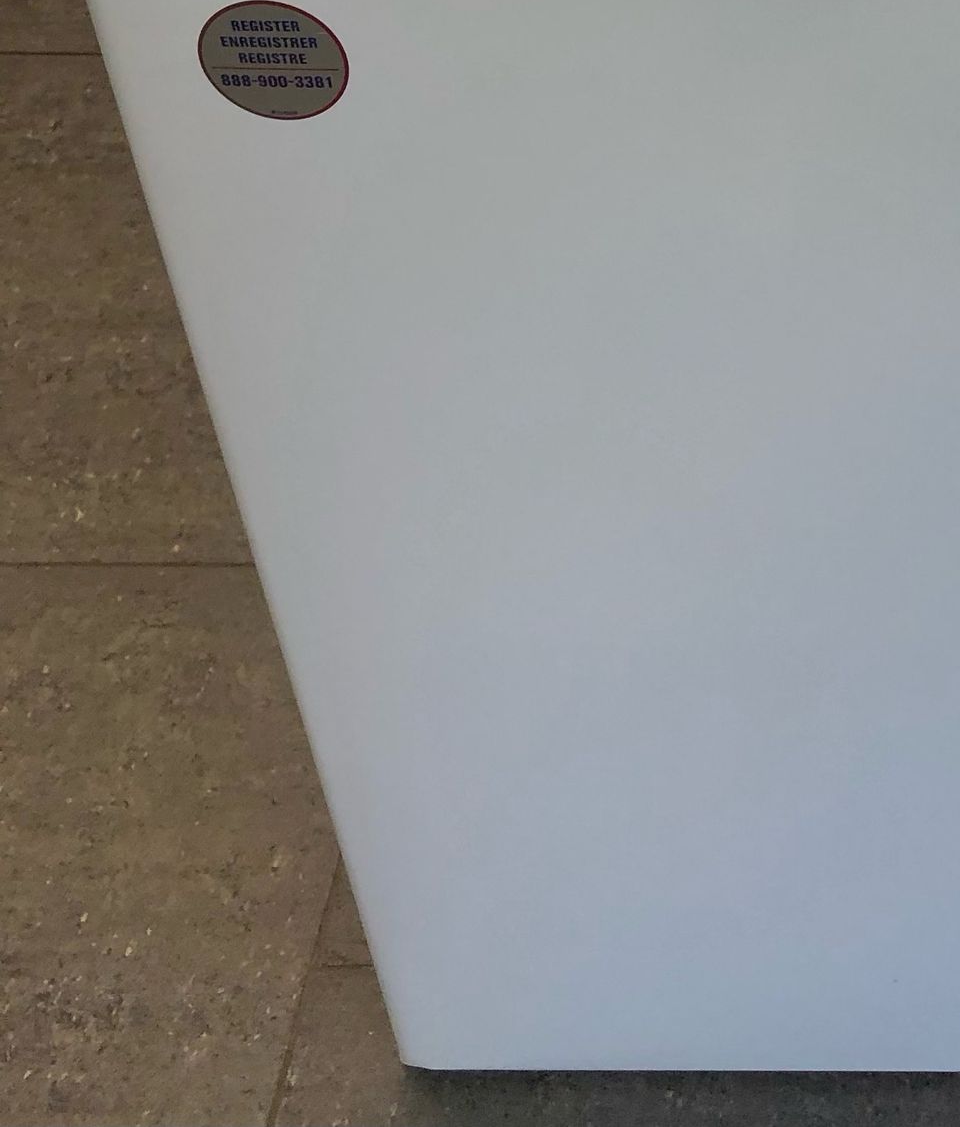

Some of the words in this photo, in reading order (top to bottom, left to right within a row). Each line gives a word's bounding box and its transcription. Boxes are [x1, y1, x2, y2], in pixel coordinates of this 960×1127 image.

[231, 21, 300, 32] REGISTER
[221, 37, 318, 49] ENREGISTRER
[239, 53, 307, 64] REGISTRE
[221, 75, 333, 88] 888-900-3381
